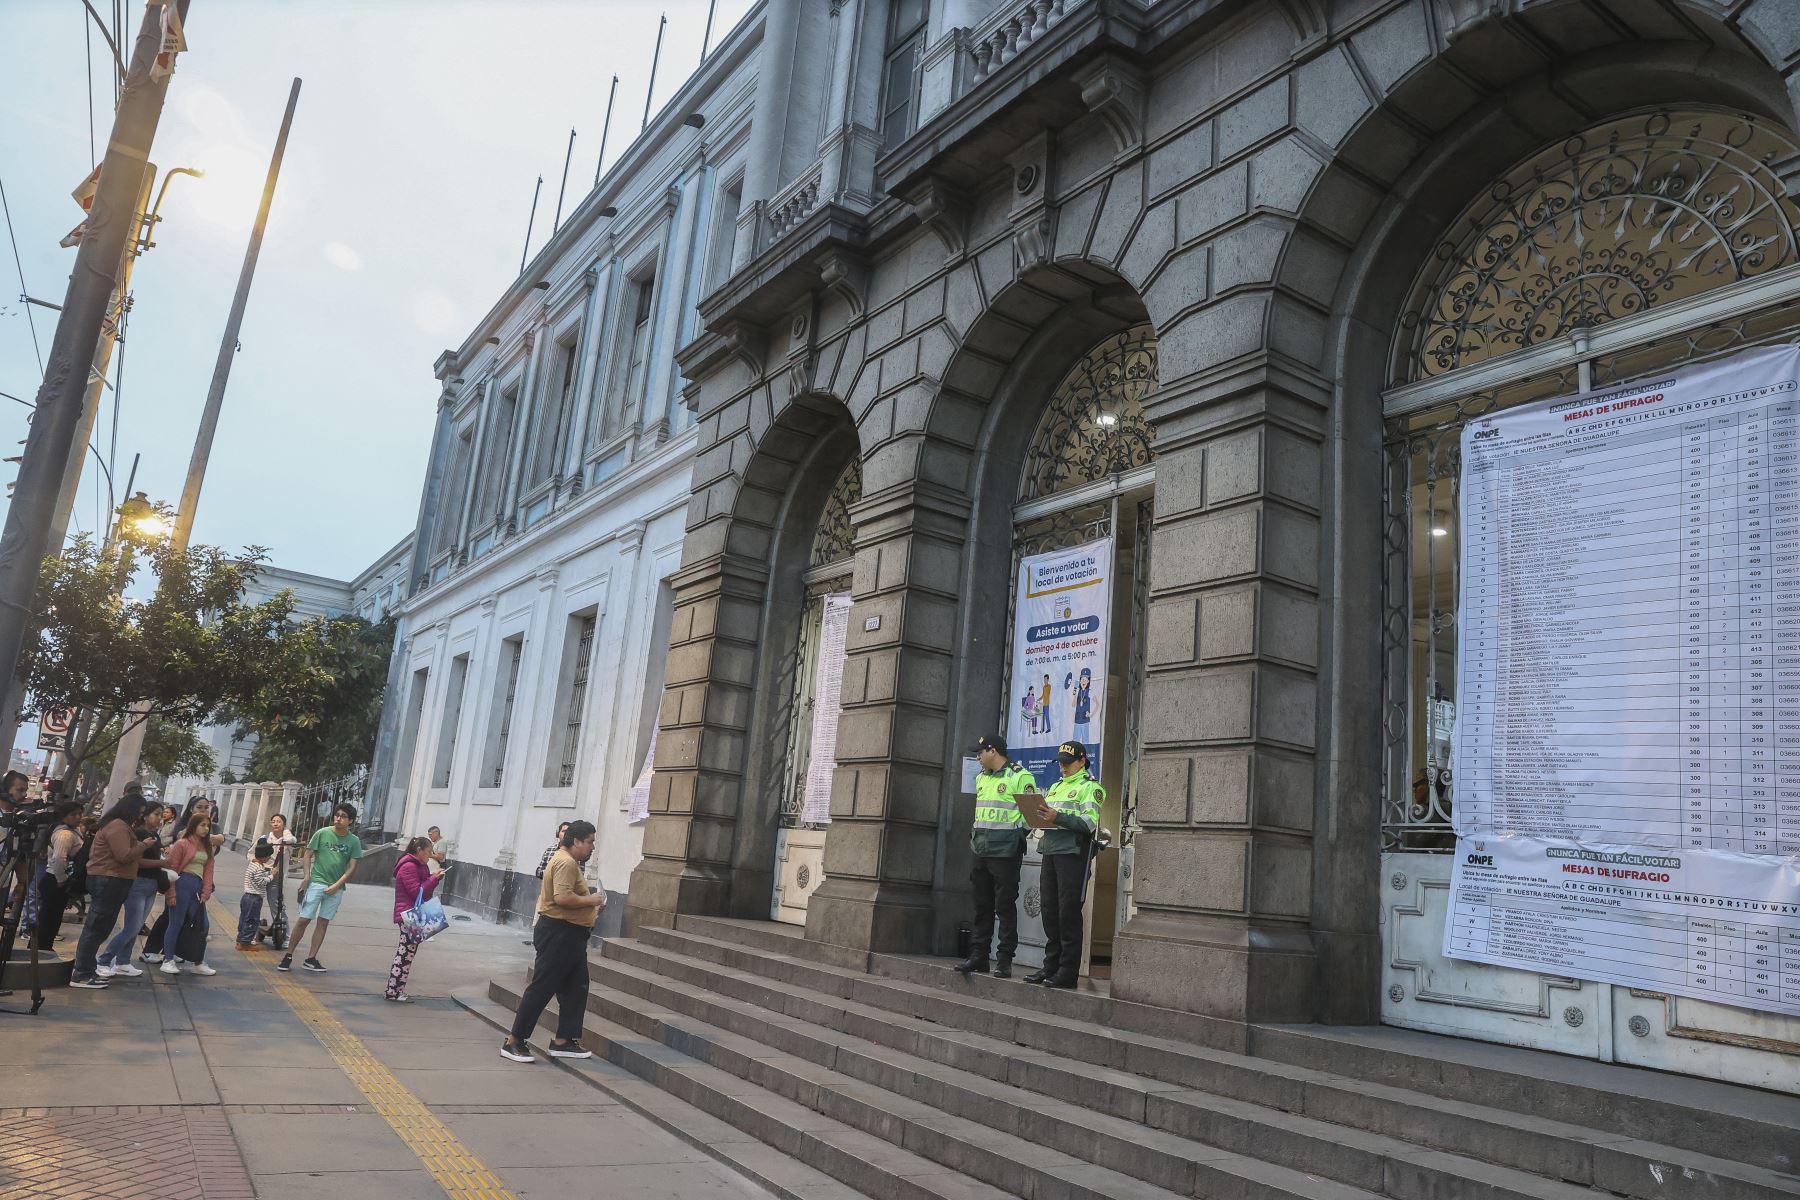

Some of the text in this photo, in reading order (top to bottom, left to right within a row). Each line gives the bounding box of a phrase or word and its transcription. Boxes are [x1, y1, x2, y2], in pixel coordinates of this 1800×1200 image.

[1600, 395, 1616, 403] TAN
[1618, 390, 1640, 399] FÁCIL
[1564, 393, 1664, 422] MESAS DE SUFRAGIO
[1474, 428, 1499, 439] ONPE
[1521, 445, 1546, 453] NUESTRA
[1583, 430, 1619, 441] GUADALUPE
[1039, 560, 1079, 576] Bienvenido
[1036, 567, 1097, 587] local de votación
[1036, 627, 1059, 638] Asiste
[1068, 621, 1089, 632] votar
[1026, 644, 1054, 655] domingo
[1072, 637, 1098, 647] octubre
[1068, 652, 1080, 660] 5:00
[1468, 854, 1493, 866] ONPE
[1548, 849, 1680, 868] ¡NUNCA FUE TAN FÁCIL VOTAR!
[1562, 864, 1669, 883] MESAS DE SUFRAGIO
[1514, 890, 1541, 898] NUESTRA
[1543, 890, 1568, 900] SEÑORA
[1580, 896, 1620, 907] GUADALUPE
